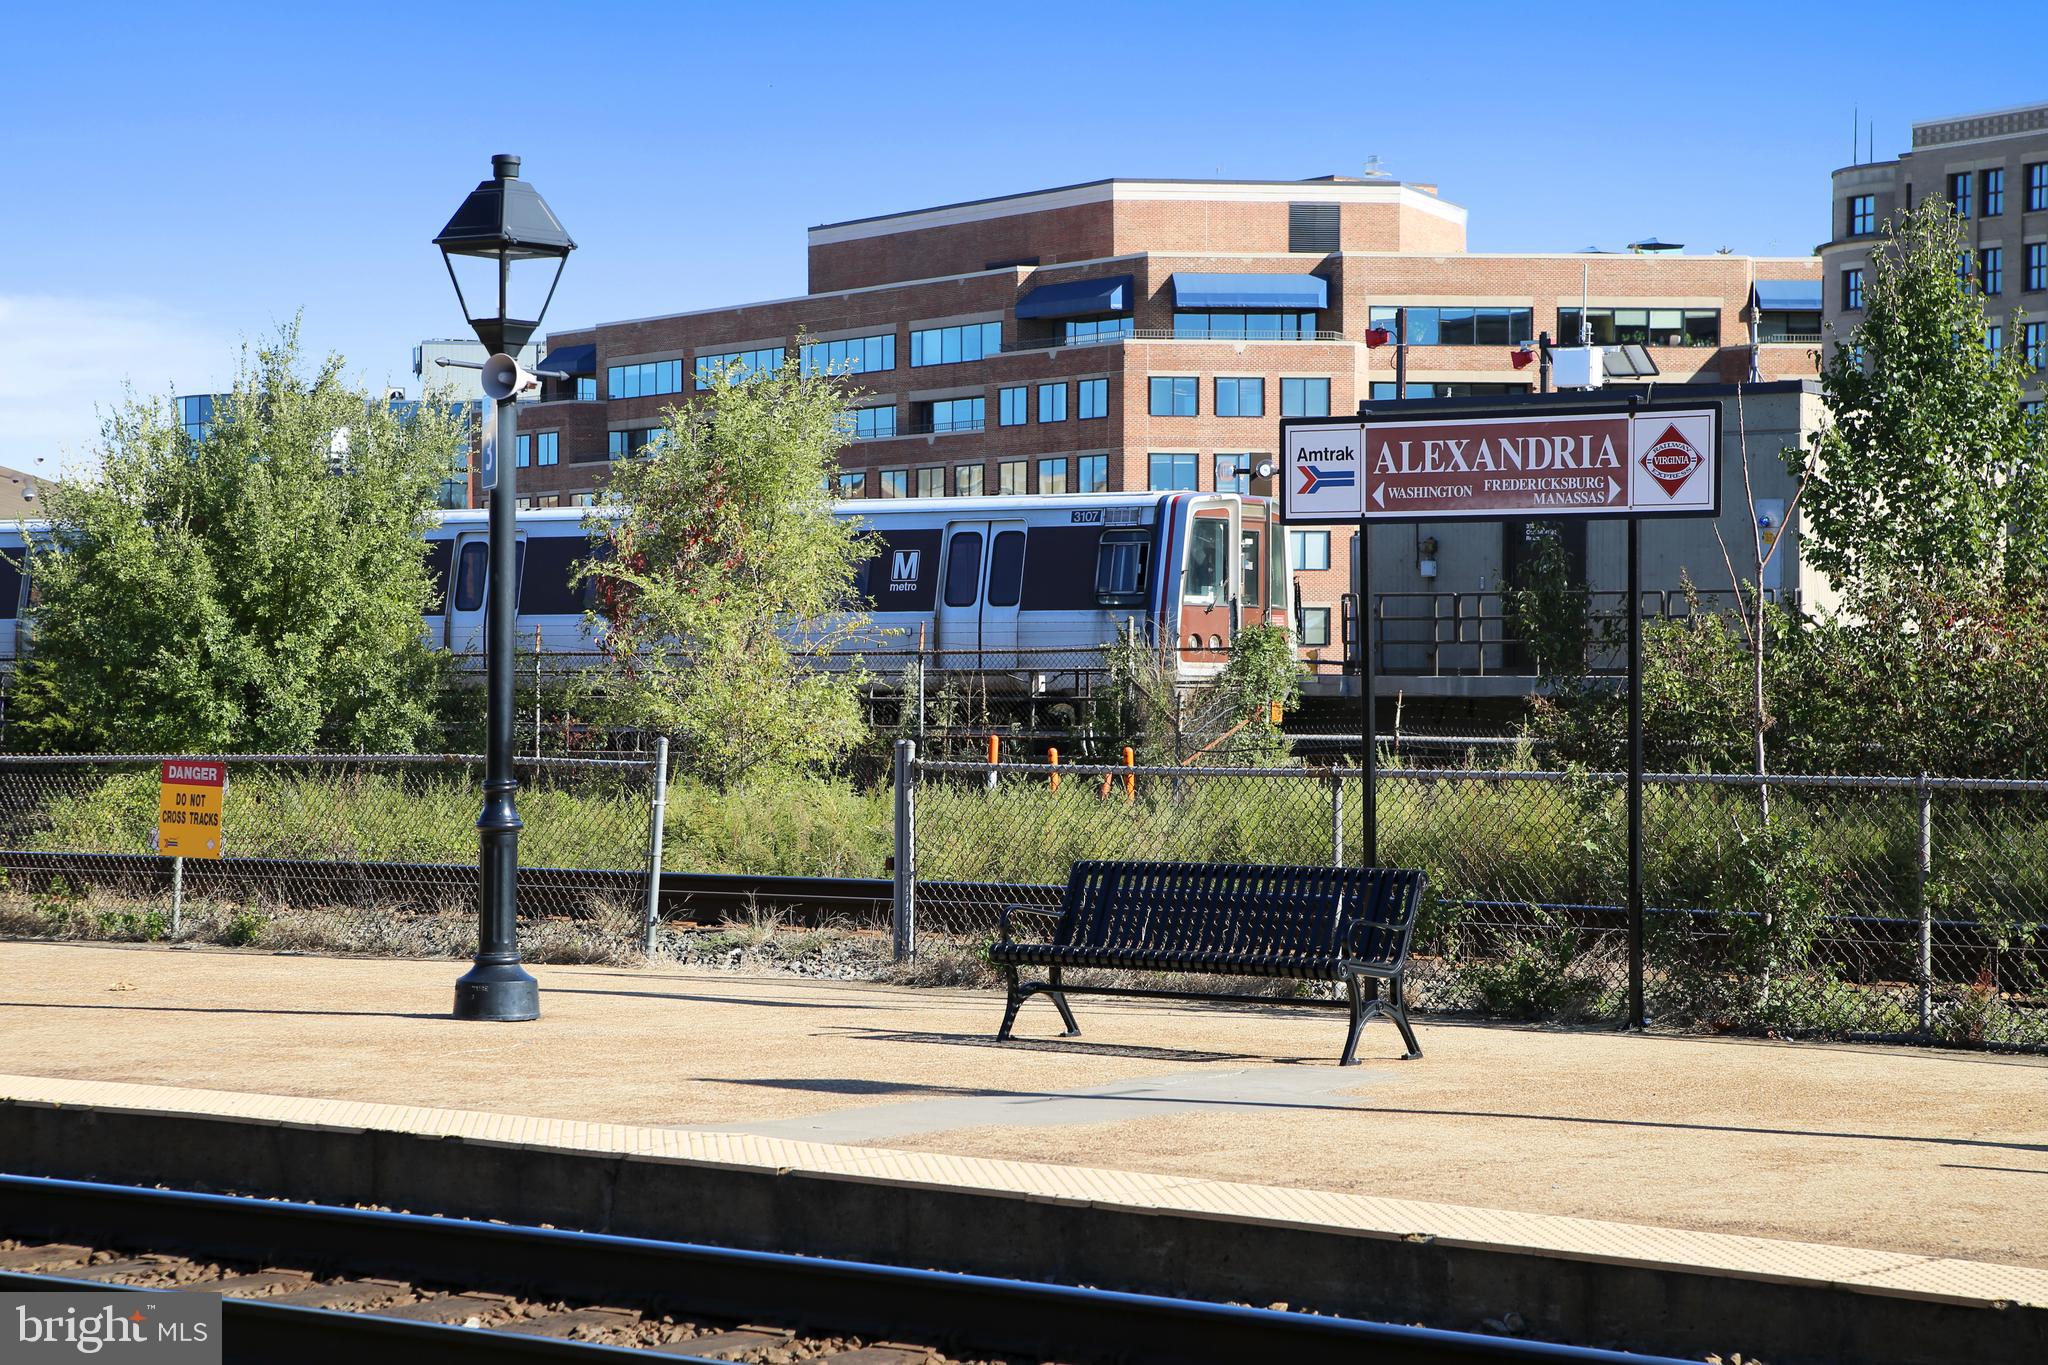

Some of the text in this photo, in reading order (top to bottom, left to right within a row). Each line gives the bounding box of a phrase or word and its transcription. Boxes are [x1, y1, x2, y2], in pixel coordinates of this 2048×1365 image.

[1296, 446, 1355, 462] Amtrak
[1373, 434, 1621, 474] ALEXANDRIA
[1653, 442, 1692, 453] RAILWAY
[1654, 455, 1690, 465] VIRGINIA
[1651, 467, 1692, 479] EXPRESS
[1484, 476, 1604, 491] FREDERICKSBURG
[1388, 485, 1473, 499] WASHINGTON
[1533, 491, 1605, 505] MANASSAS
[1073, 511, 1099, 522] 3107
[893, 552, 918, 579] M
[889, 582, 917, 592] metro
[168, 765, 217, 781] DANGER
[175, 793, 206, 807] DO NOT
[162, 810, 219, 826] CROSS TRACKS
